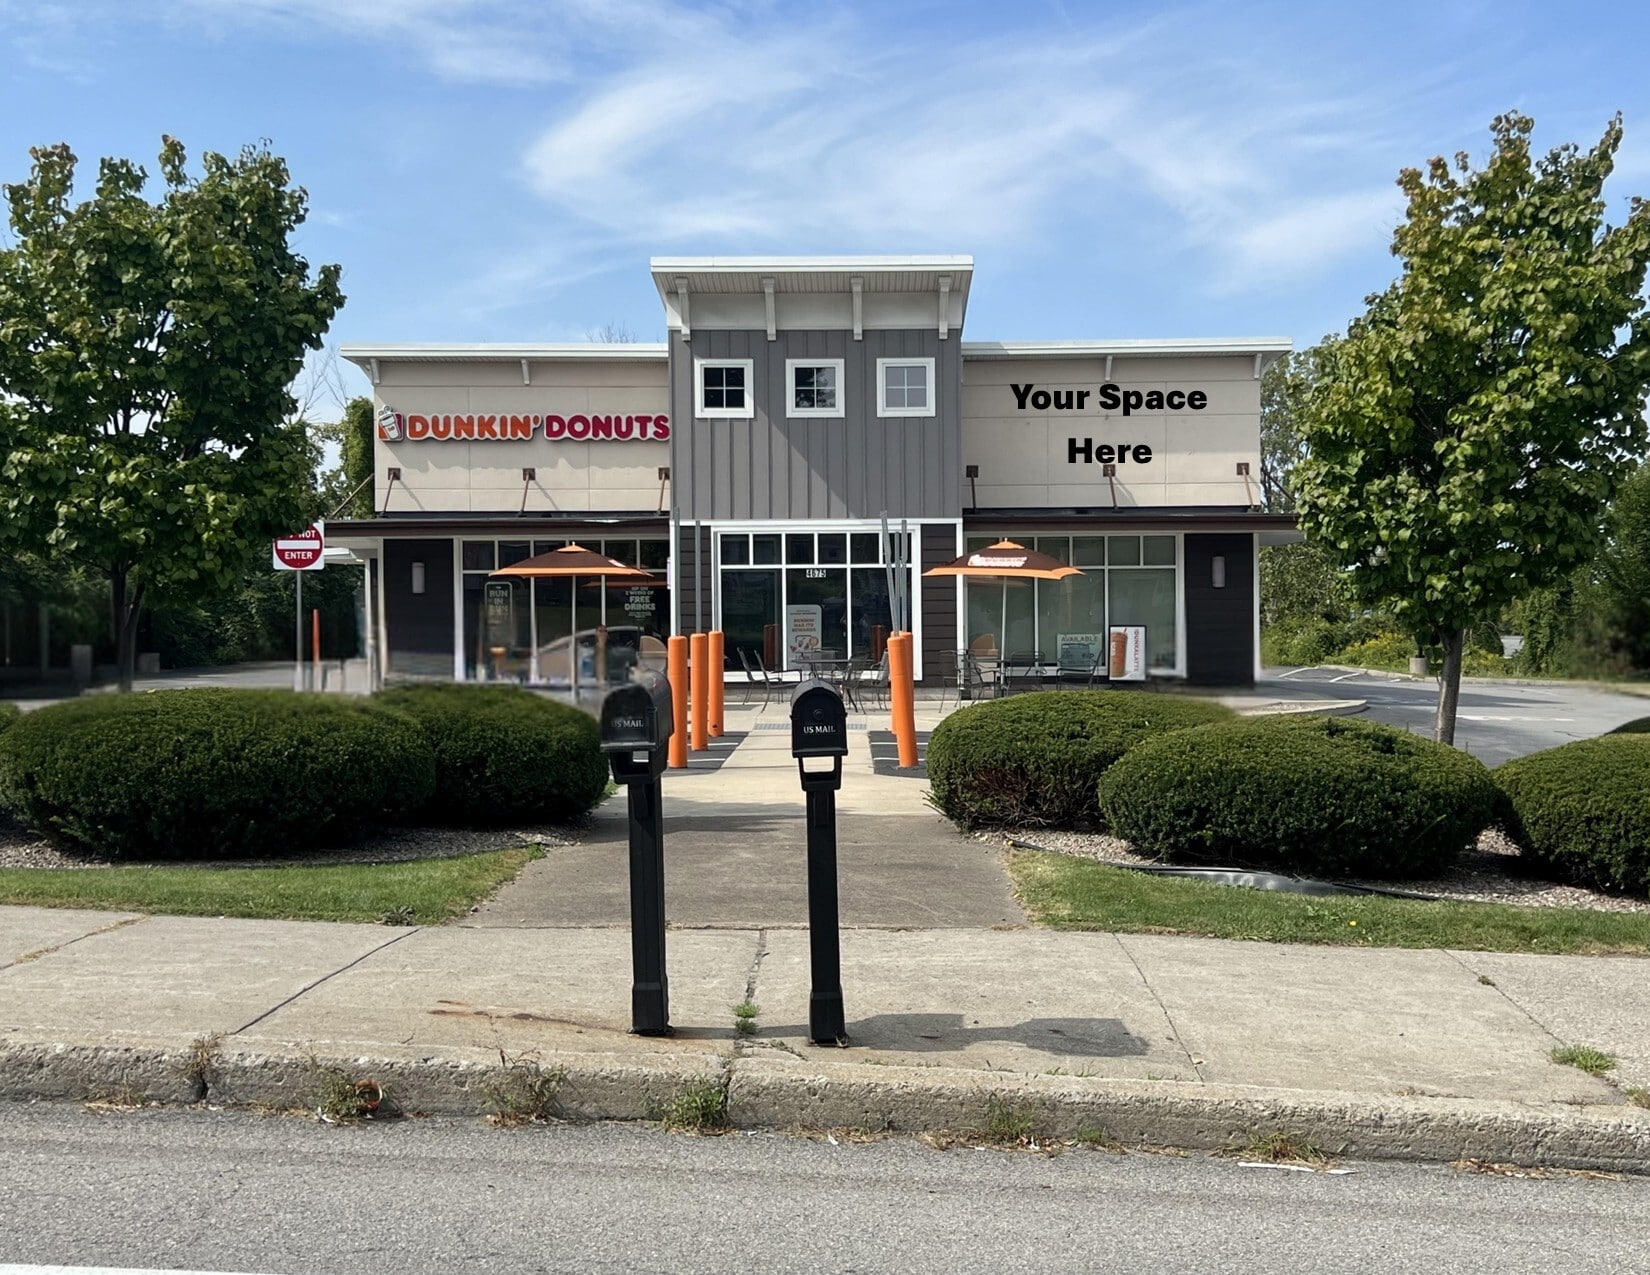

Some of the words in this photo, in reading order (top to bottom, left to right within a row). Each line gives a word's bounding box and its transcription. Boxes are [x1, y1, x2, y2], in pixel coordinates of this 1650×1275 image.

[408, 415, 540, 439] DUNKIN'
[545, 414, 670, 439] DONUTS
[284, 551, 313, 560] ENTER
[624, 603, 656, 611] DRINKS
[611, 720, 622, 728] US
[623, 720, 644, 728] MAIL
[803, 726, 814, 734] US
[815, 725, 836, 733] MAIL
